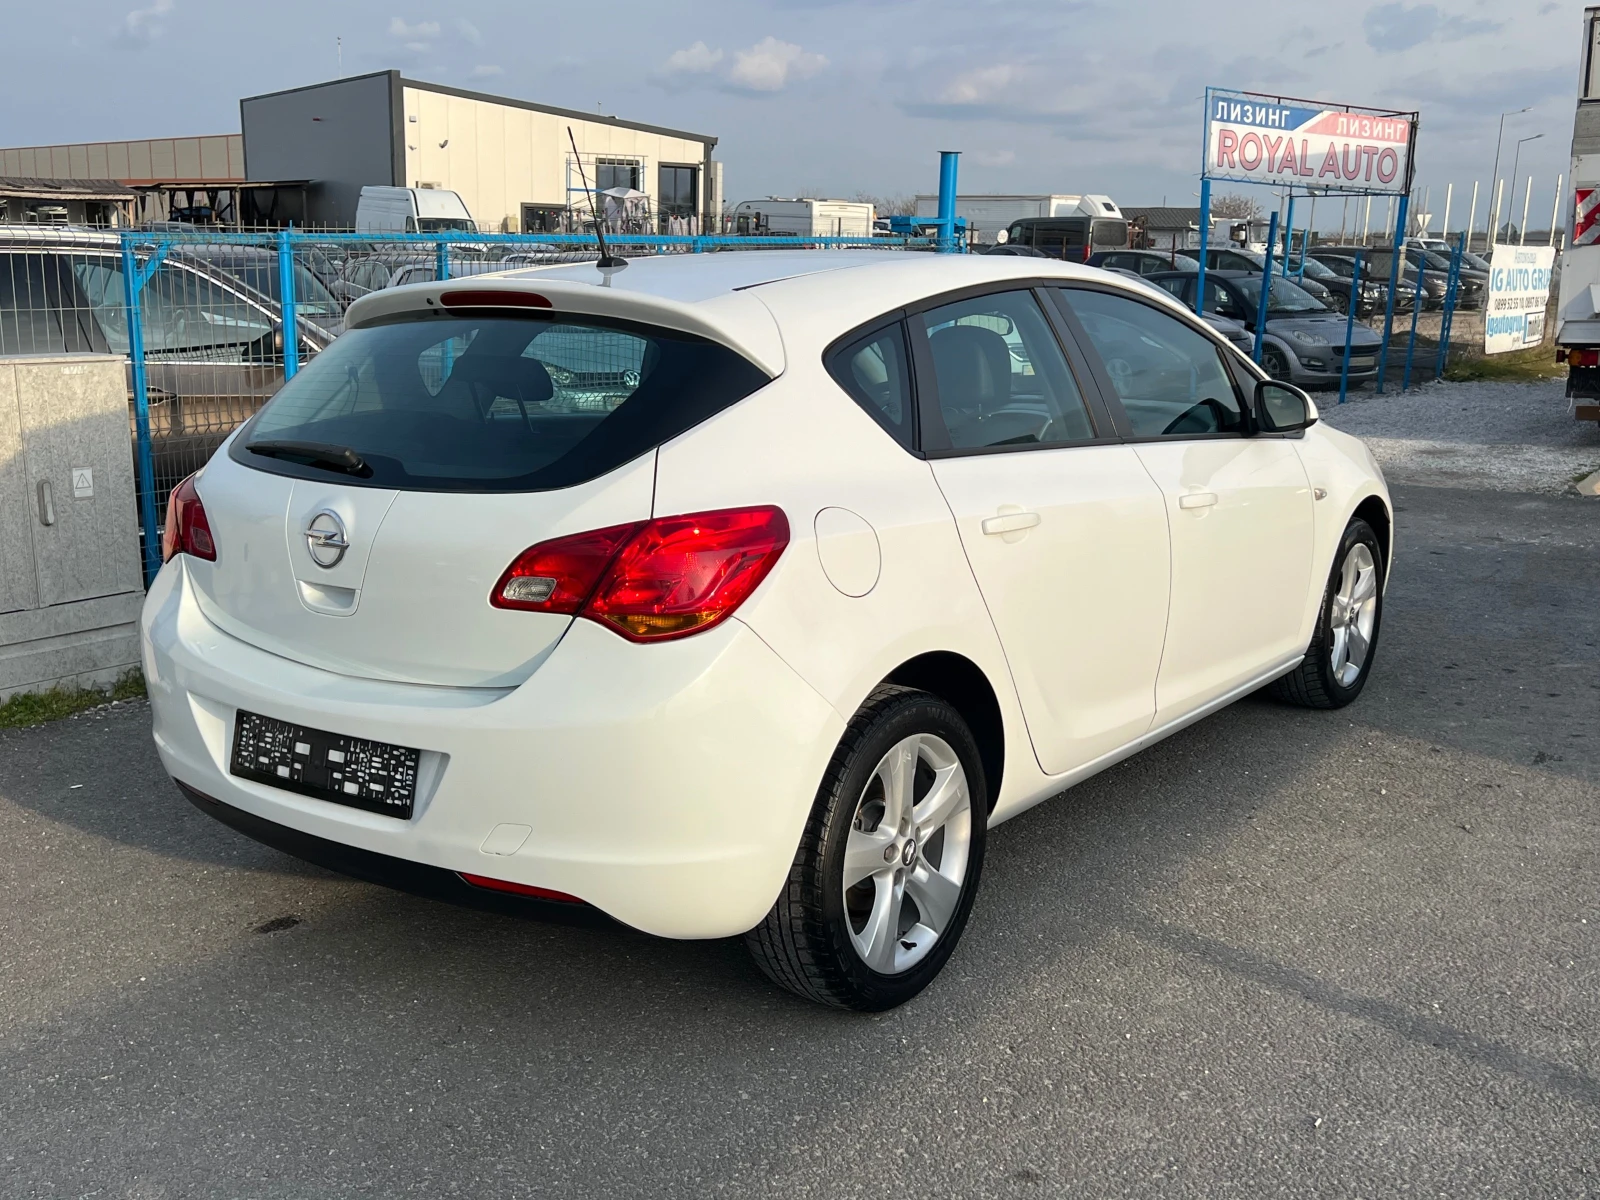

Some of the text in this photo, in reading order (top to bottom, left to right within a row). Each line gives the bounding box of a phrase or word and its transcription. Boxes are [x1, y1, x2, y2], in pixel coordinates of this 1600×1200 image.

[1216, 101, 1290, 128] ЛИЗИНГ
[1336, 117, 1405, 140] ЛИЗИНГ
[1217, 128, 1399, 184] ROYAL AUTO
[1490, 267, 1503, 292] IG
[1504, 268, 1529, 292] AUTO
